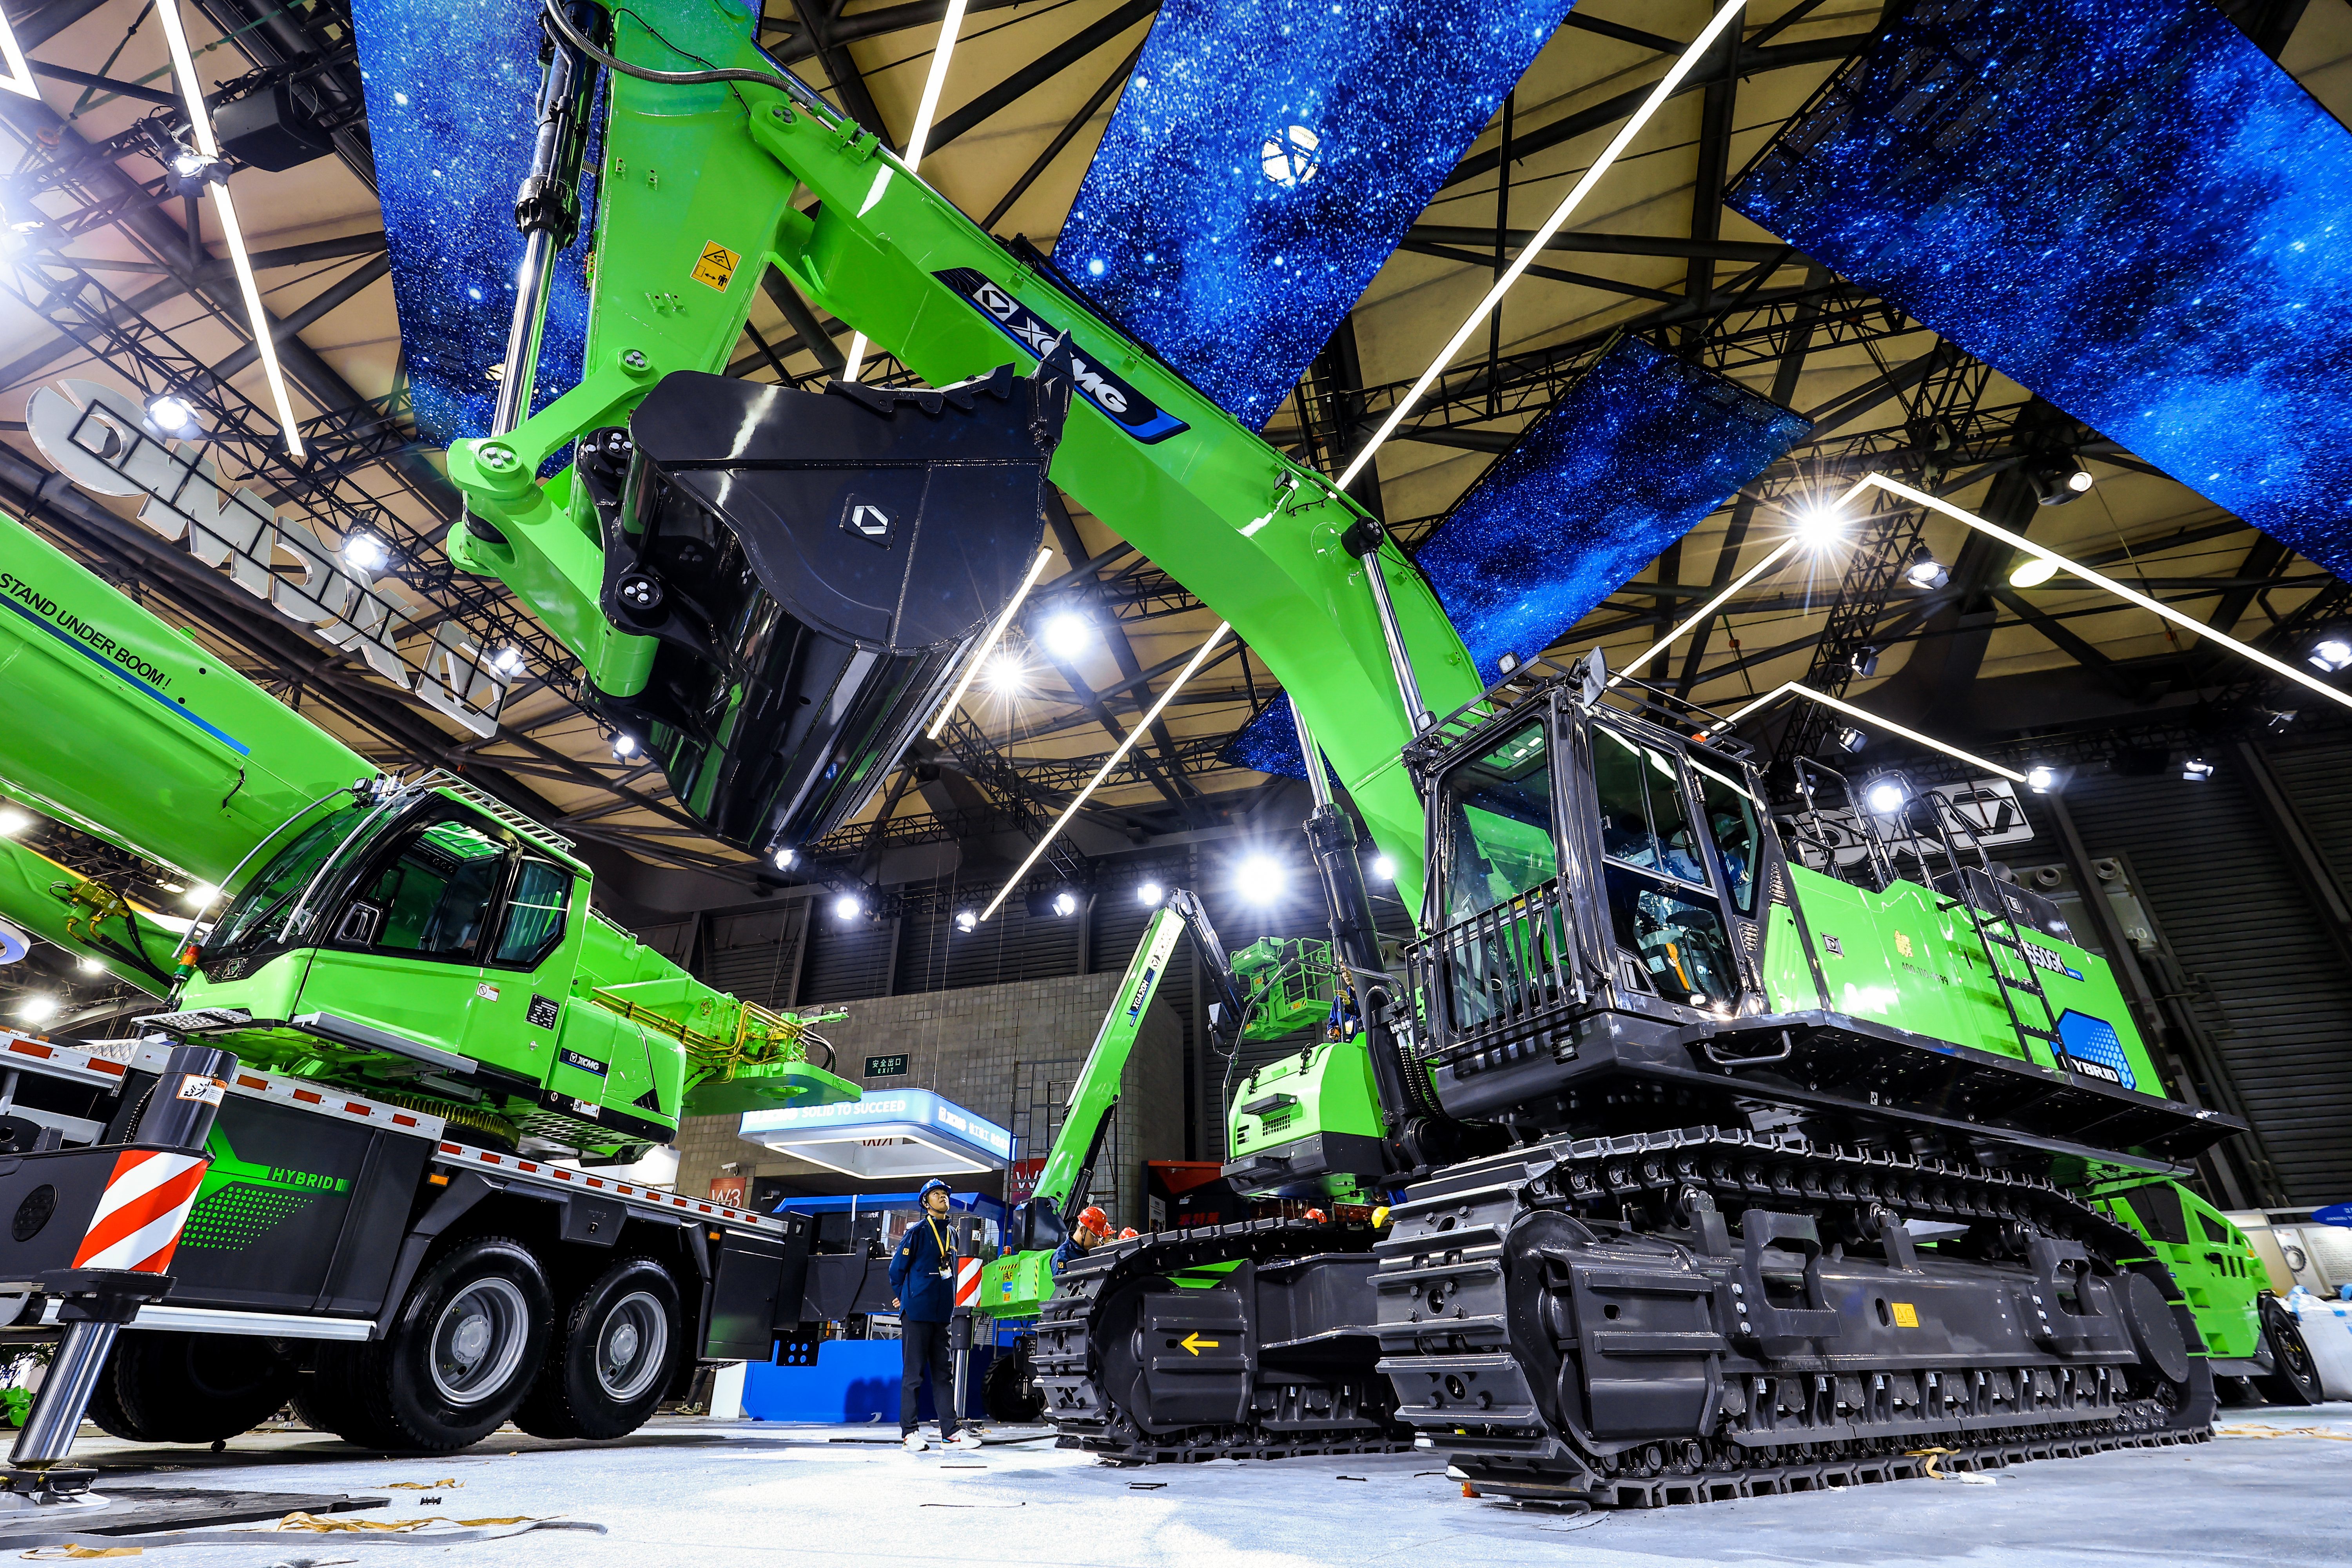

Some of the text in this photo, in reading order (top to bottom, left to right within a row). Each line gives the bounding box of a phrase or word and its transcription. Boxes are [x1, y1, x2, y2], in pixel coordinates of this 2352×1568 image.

[0, 573, 57, 616] STAND
[56, 610, 116, 656] UNDER
[576, 1056, 599, 1071] XCMG
[872, 1058, 901, 1068] 安全出口
[801, 1105, 835, 1118] SOLID
[837, 1104, 849, 1116] TO
[853, 1100, 906, 1115] SUCCEED
[271, 1167, 334, 1189] HYBRID
[711, 1189, 741, 1208] W3
